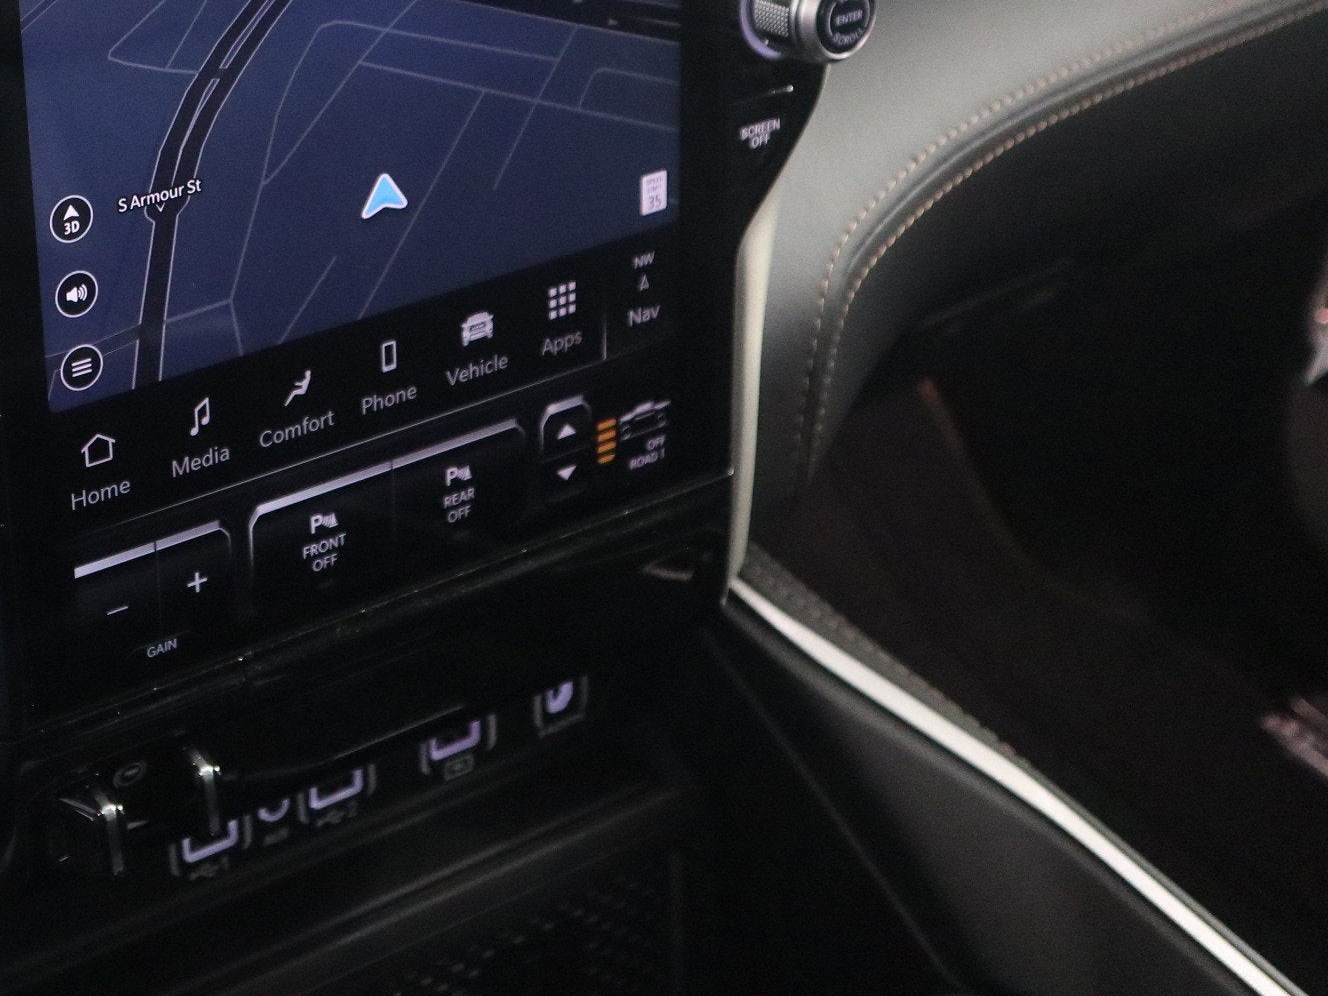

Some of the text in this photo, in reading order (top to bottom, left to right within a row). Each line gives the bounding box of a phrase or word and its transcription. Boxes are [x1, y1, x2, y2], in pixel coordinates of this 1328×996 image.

[740, 118, 780, 141] SCREEN
[118, 179, 201, 212] S Armour St
[64, 220, 79, 235] 3D
[632, 251, 654, 269] NW
[628, 305, 660, 327] Nav
[542, 331, 582, 355] Apps
[446, 354, 508, 386] Vehicle
[361, 386, 417, 415] Phone
[260, 411, 334, 447] Comfort
[171, 446, 230, 478] Media
[71, 480, 131, 511] Home
[444, 488, 475, 508] REAR
[448, 505, 471, 522] OFF
[303, 533, 346, 559] FRONT
[312, 553, 337, 572] OFF
[147, 638, 177, 658] GAIN
